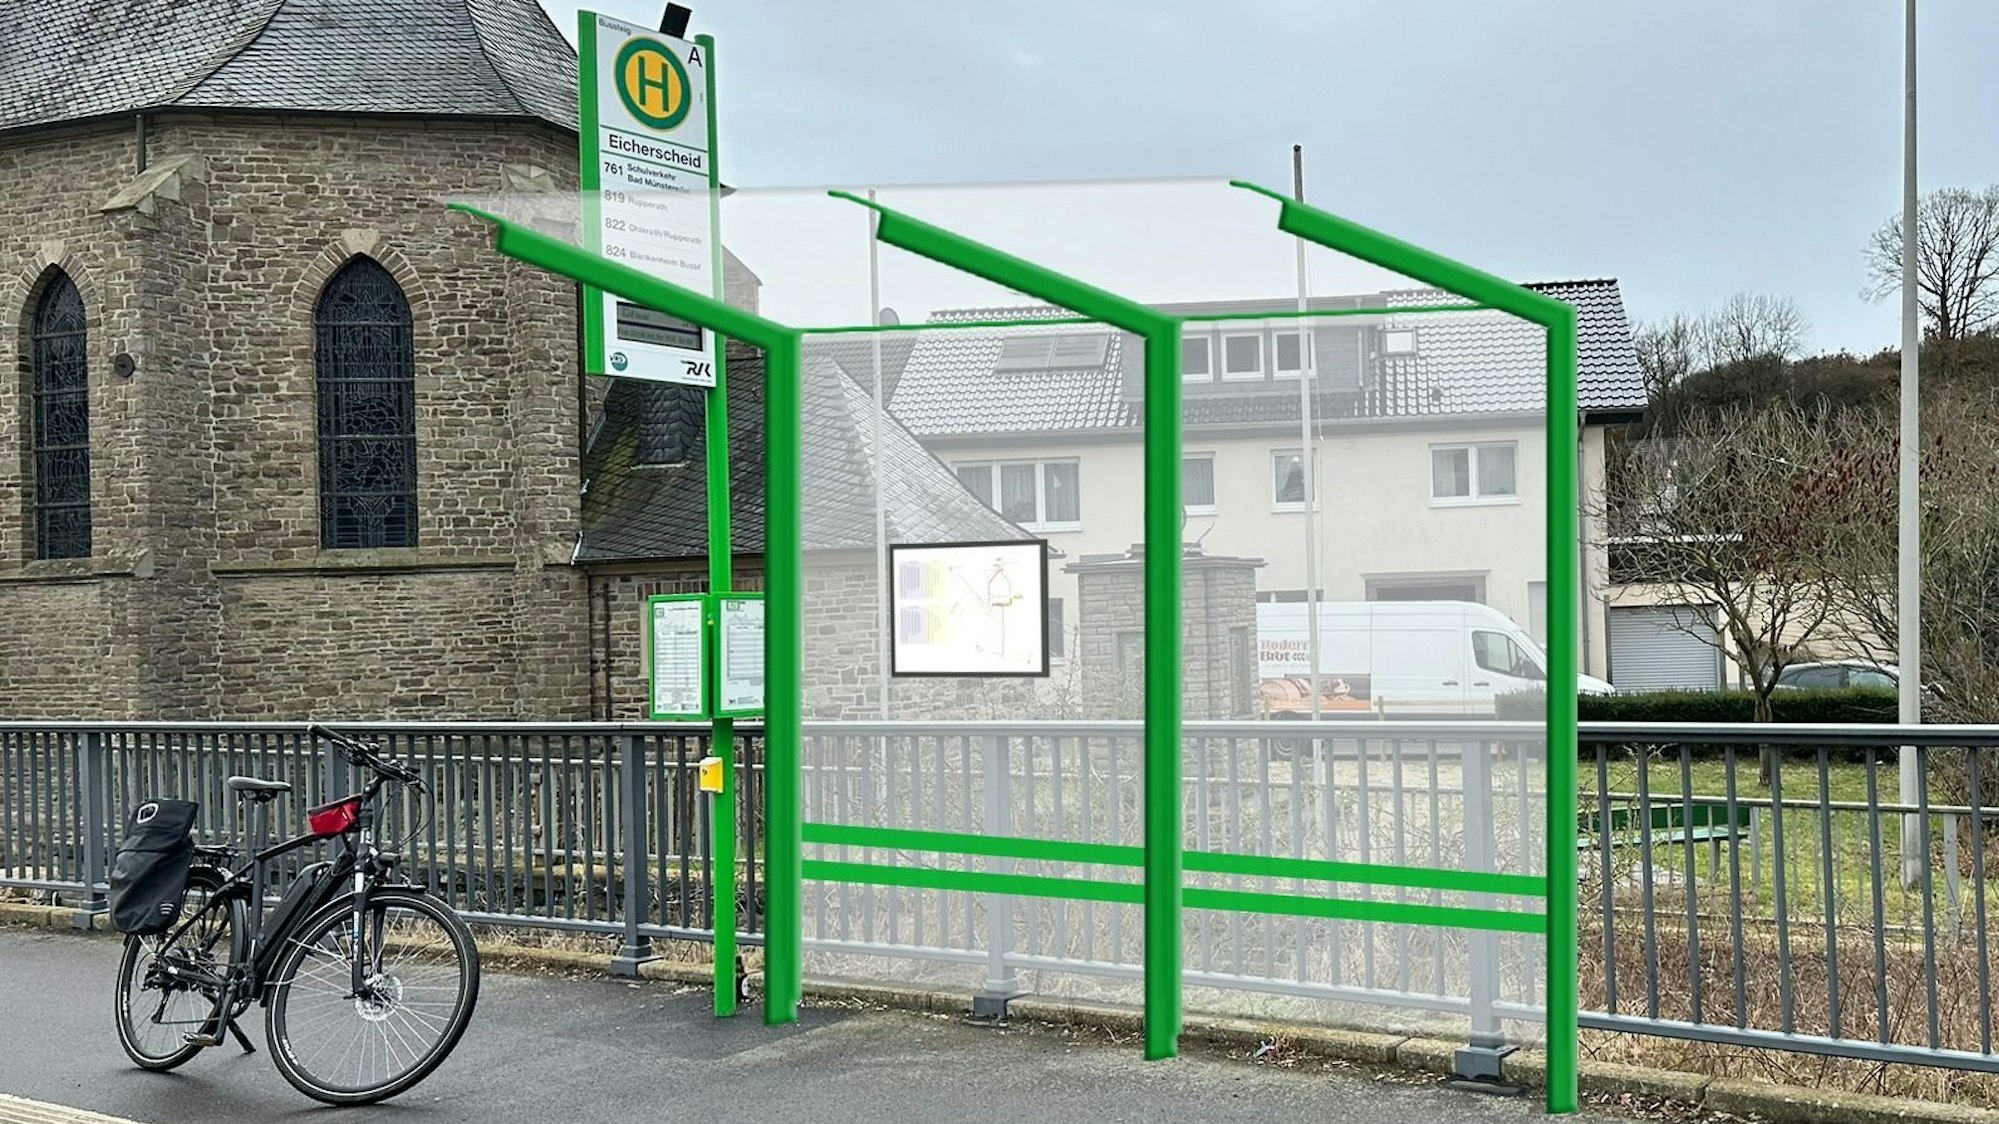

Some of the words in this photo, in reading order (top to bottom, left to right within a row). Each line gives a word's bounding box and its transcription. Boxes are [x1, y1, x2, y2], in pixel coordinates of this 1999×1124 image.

[688, 46, 702, 68] A
[638, 55, 669, 112] H
[609, 134, 701, 168] Eicherscheid
[604, 161, 623, 176] 761
[627, 163, 677, 181] Schulverkehr
[627, 175, 643, 185] Bad
[604, 189, 625, 204] 819
[605, 217, 626, 232] 822
[605, 245, 626, 259] 824
[1260, 651, 1290, 661] Brot
